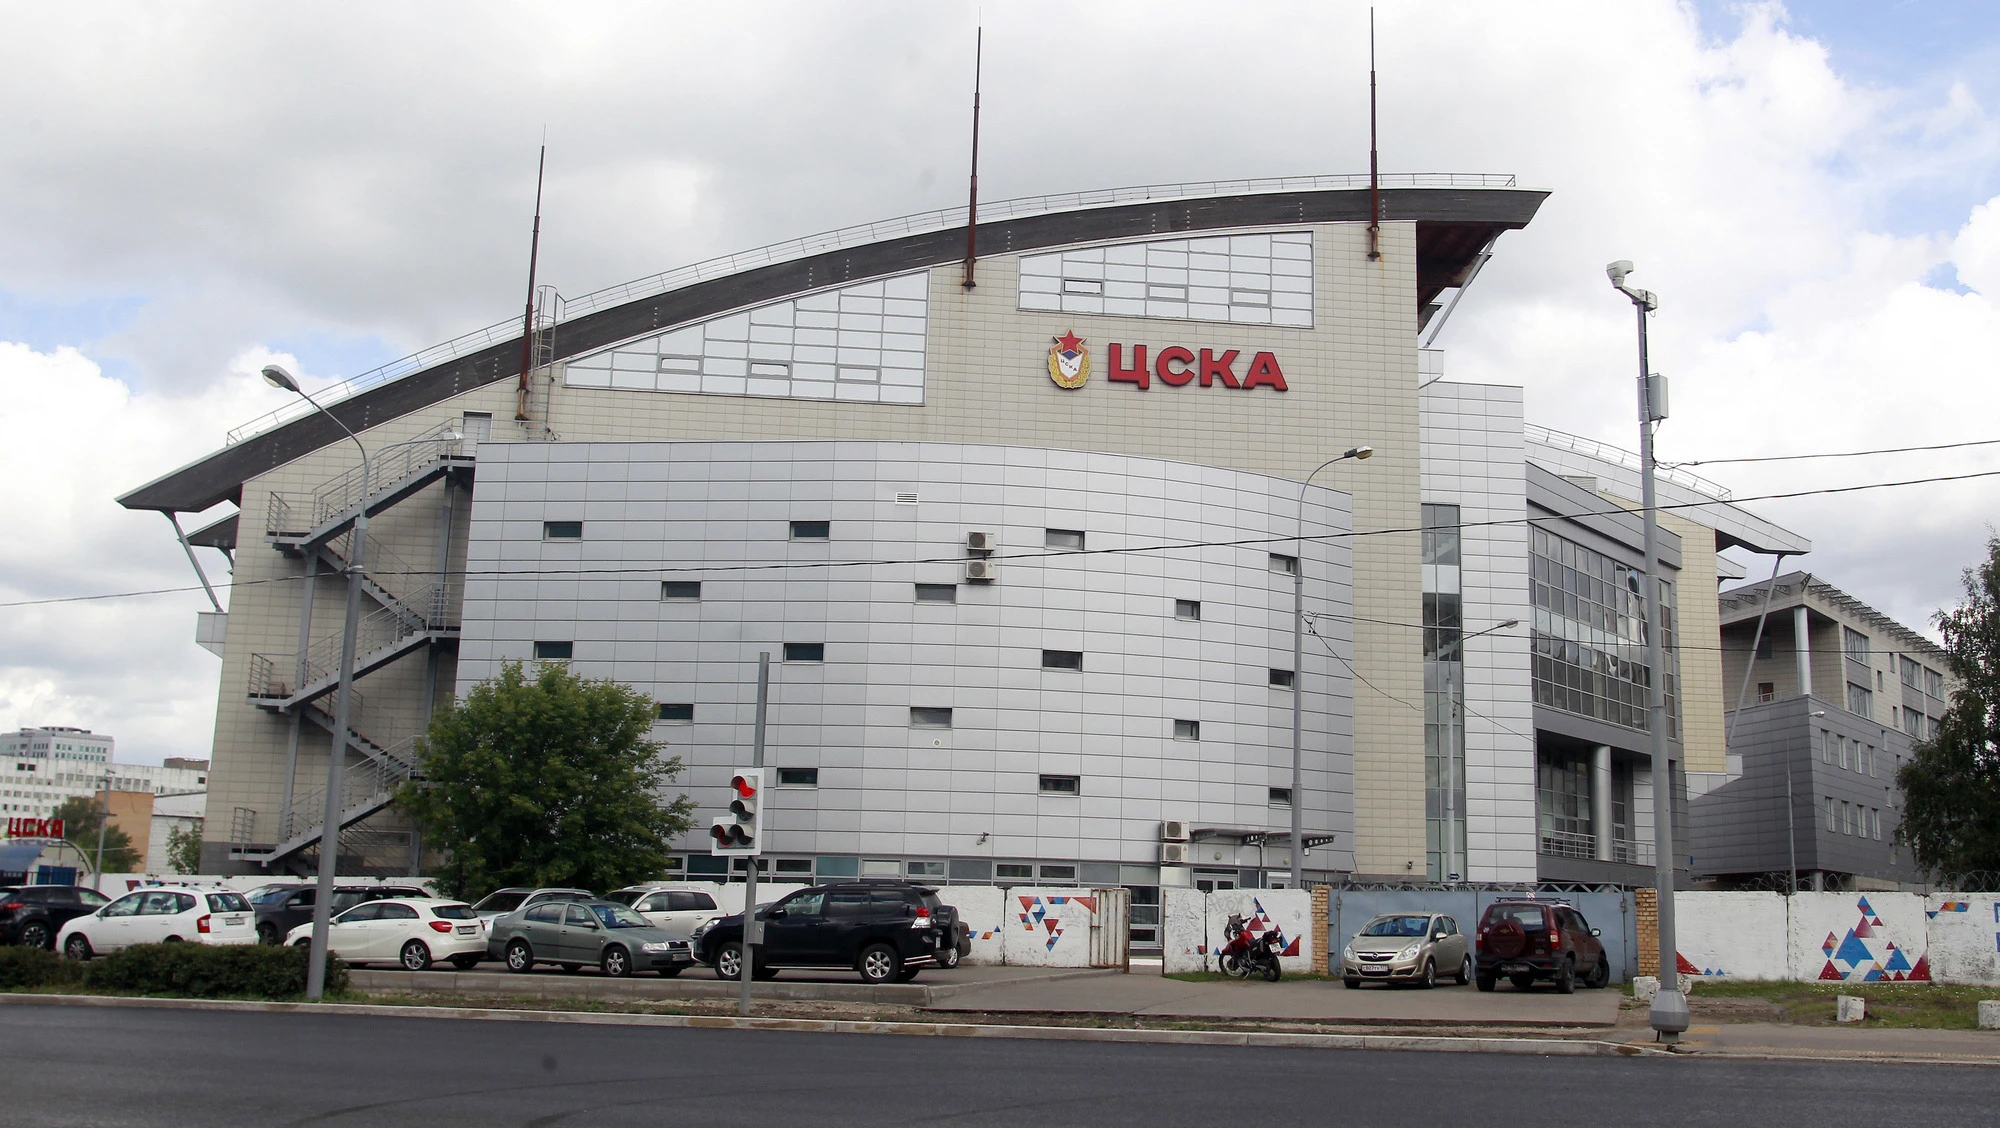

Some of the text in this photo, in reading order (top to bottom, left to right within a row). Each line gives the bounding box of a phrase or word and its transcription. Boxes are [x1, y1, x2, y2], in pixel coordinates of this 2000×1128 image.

[1060, 358, 1078, 372] ЦСКА
[1108, 342, 1289, 391] ЦСКА
[7, 817, 65, 839] ЦСКА
